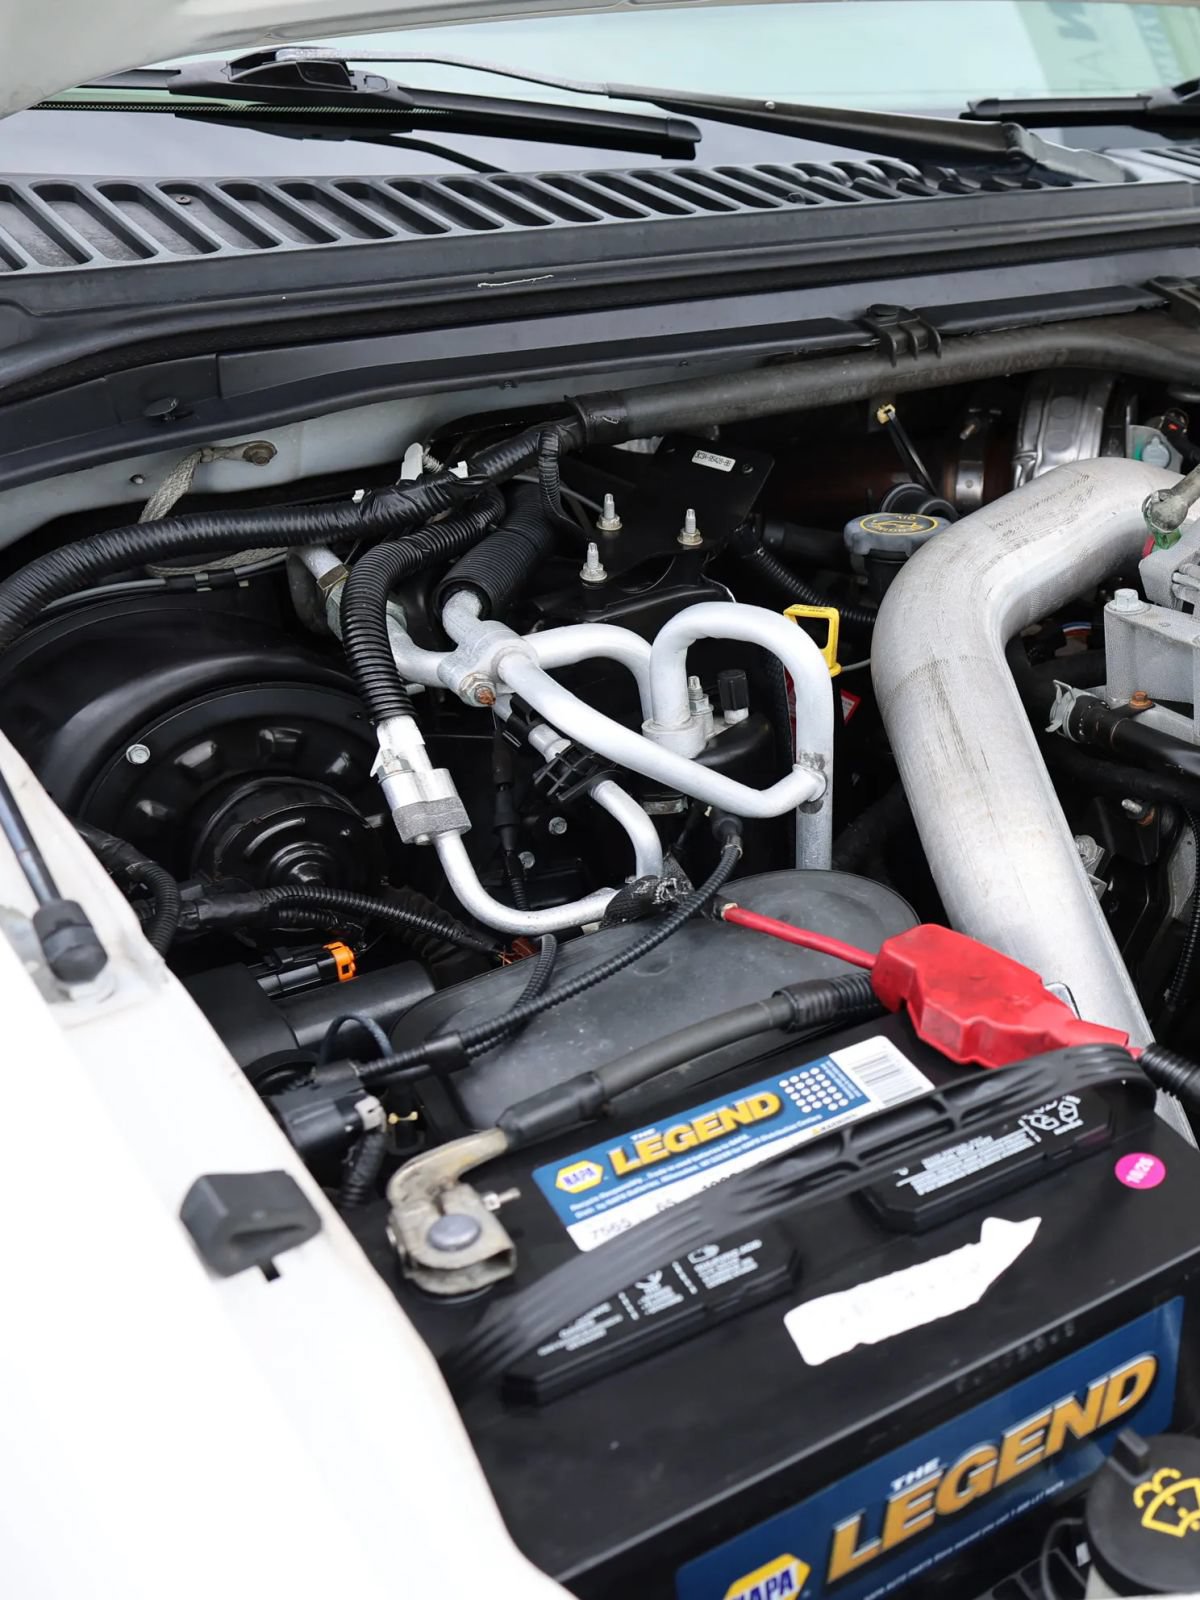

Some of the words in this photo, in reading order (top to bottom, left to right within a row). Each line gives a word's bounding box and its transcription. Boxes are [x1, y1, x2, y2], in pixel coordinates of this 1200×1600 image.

[607, 1091, 782, 1176] LEGEND
[562, 1167, 596, 1186] NAPA
[826, 1353, 1158, 1584] LEGEND
[890, 1458, 940, 1491] THE
